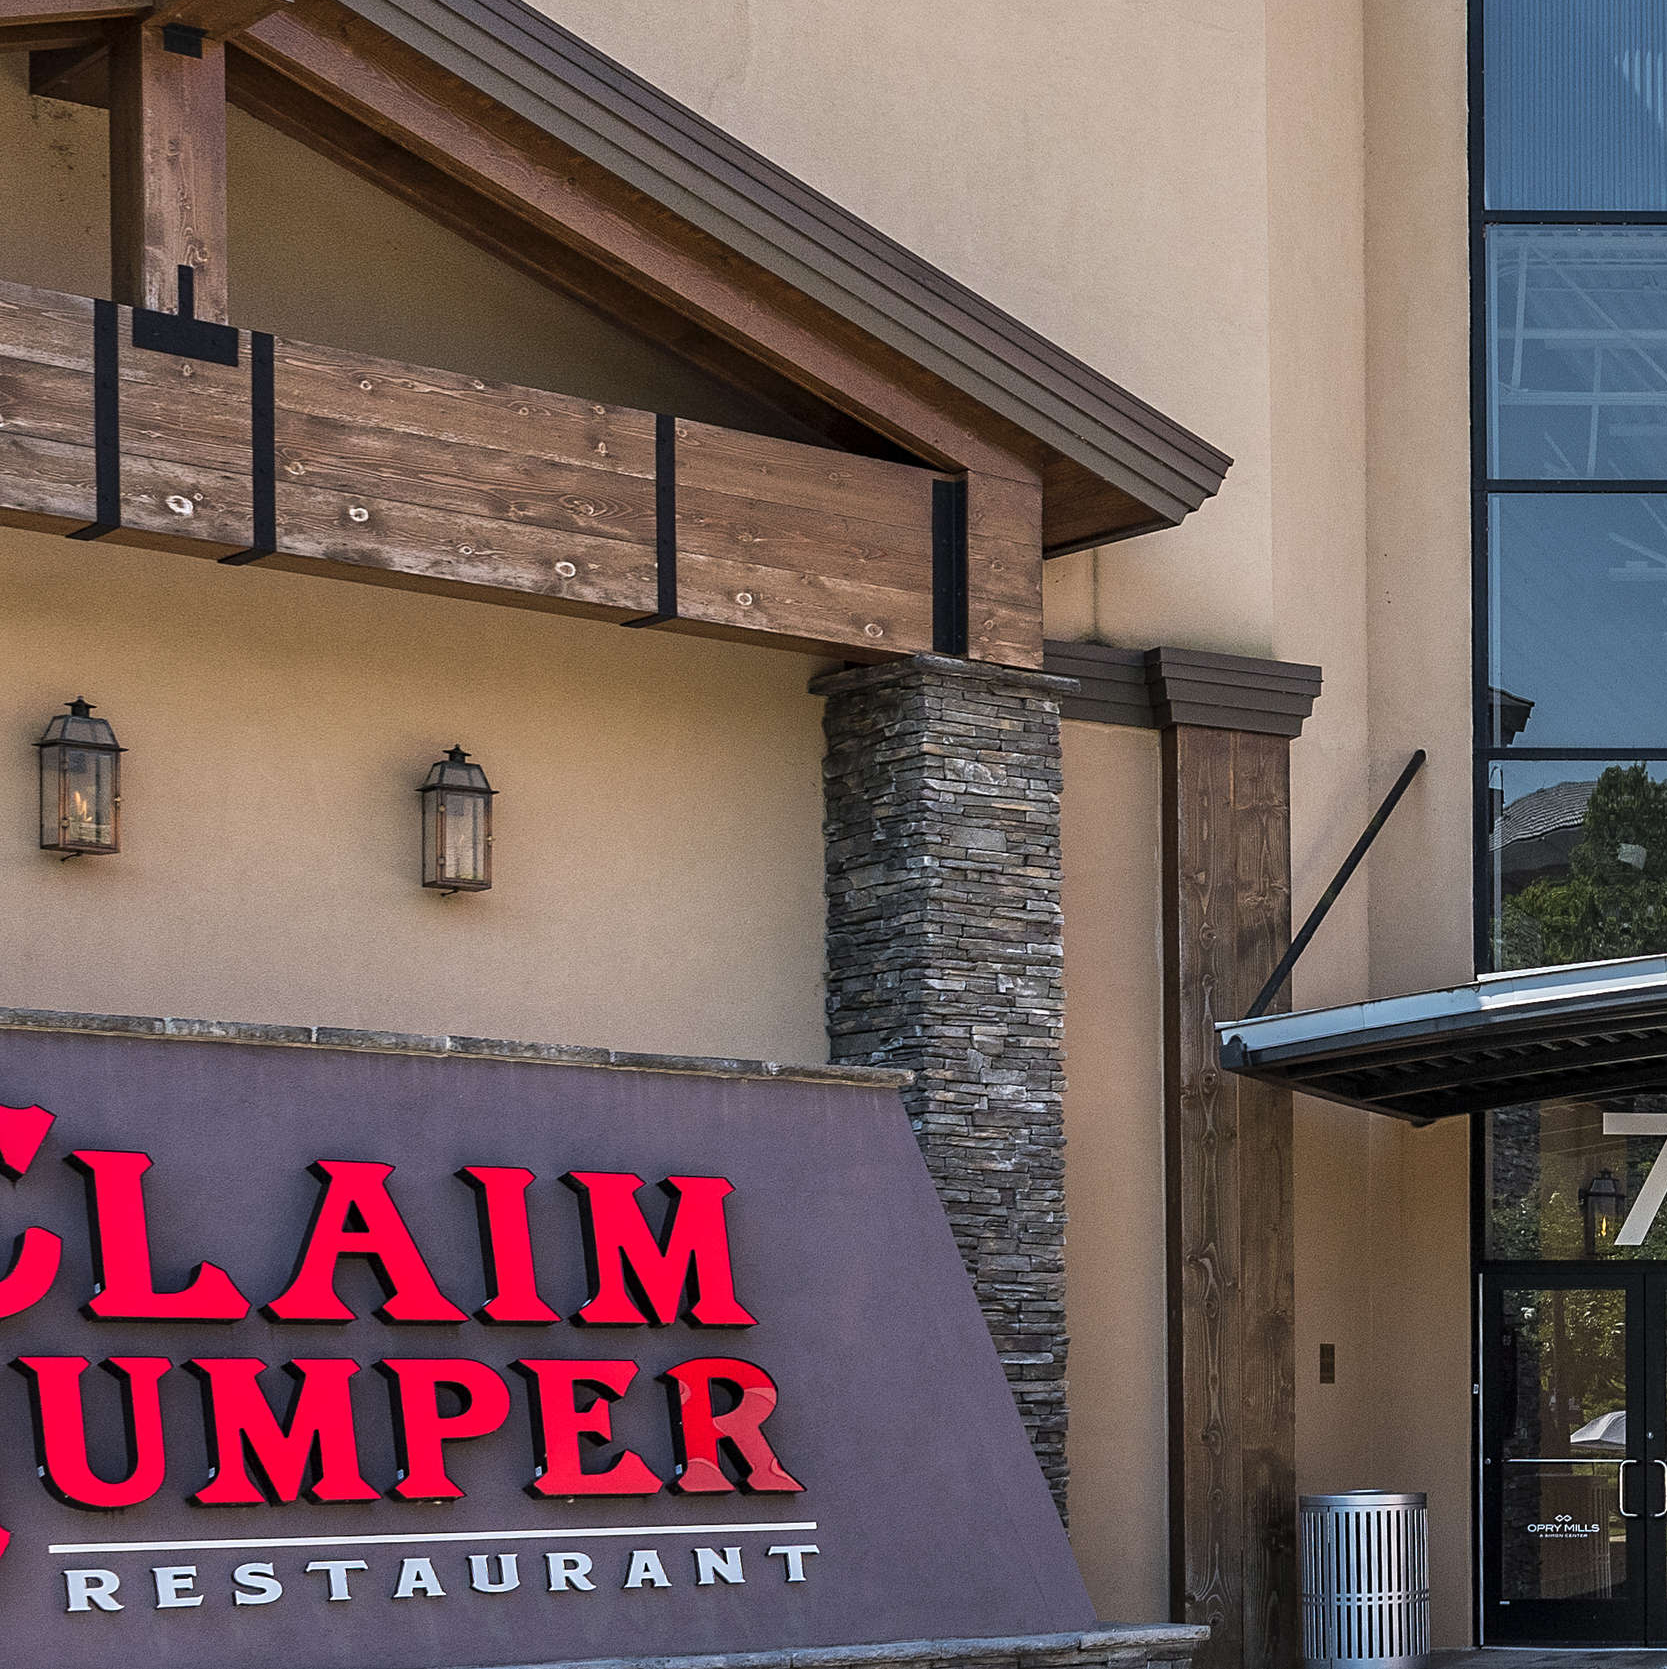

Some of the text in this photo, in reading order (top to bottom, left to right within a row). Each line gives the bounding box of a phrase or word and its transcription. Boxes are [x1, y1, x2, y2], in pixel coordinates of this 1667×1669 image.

[0, 1355, 806, 1557] UMPER
[1527, 1524, 1600, 1532] OPRY MILLS
[62, 1543, 820, 1613] RESTAURANT
